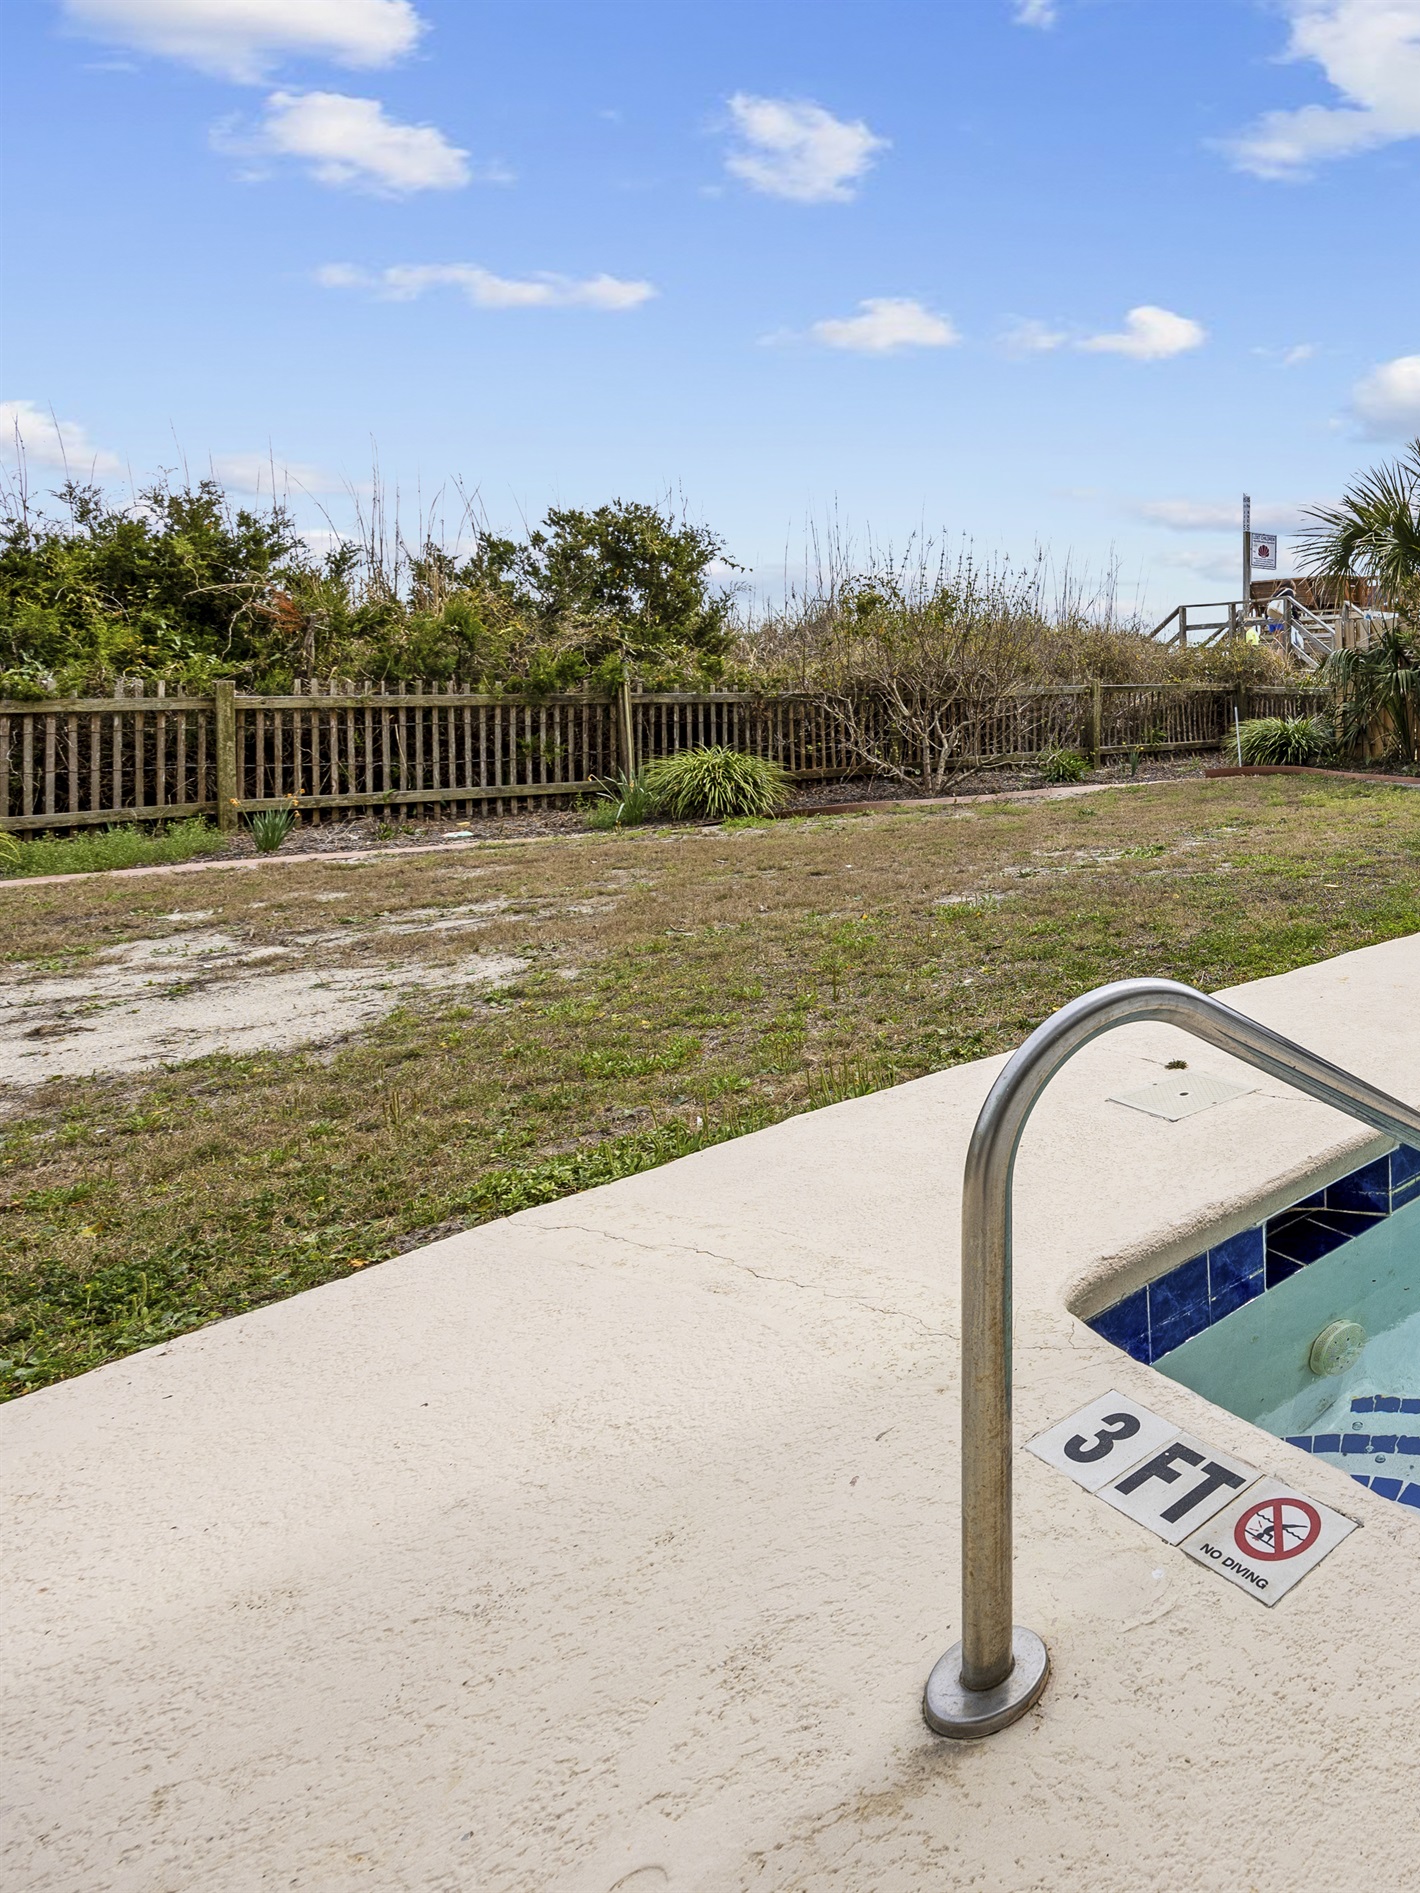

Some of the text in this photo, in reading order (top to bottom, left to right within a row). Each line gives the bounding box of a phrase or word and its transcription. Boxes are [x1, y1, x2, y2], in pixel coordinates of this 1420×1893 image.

[1063, 1412, 1247, 1524] 3 FT
[1199, 1543, 1269, 1591] NO DIVING
